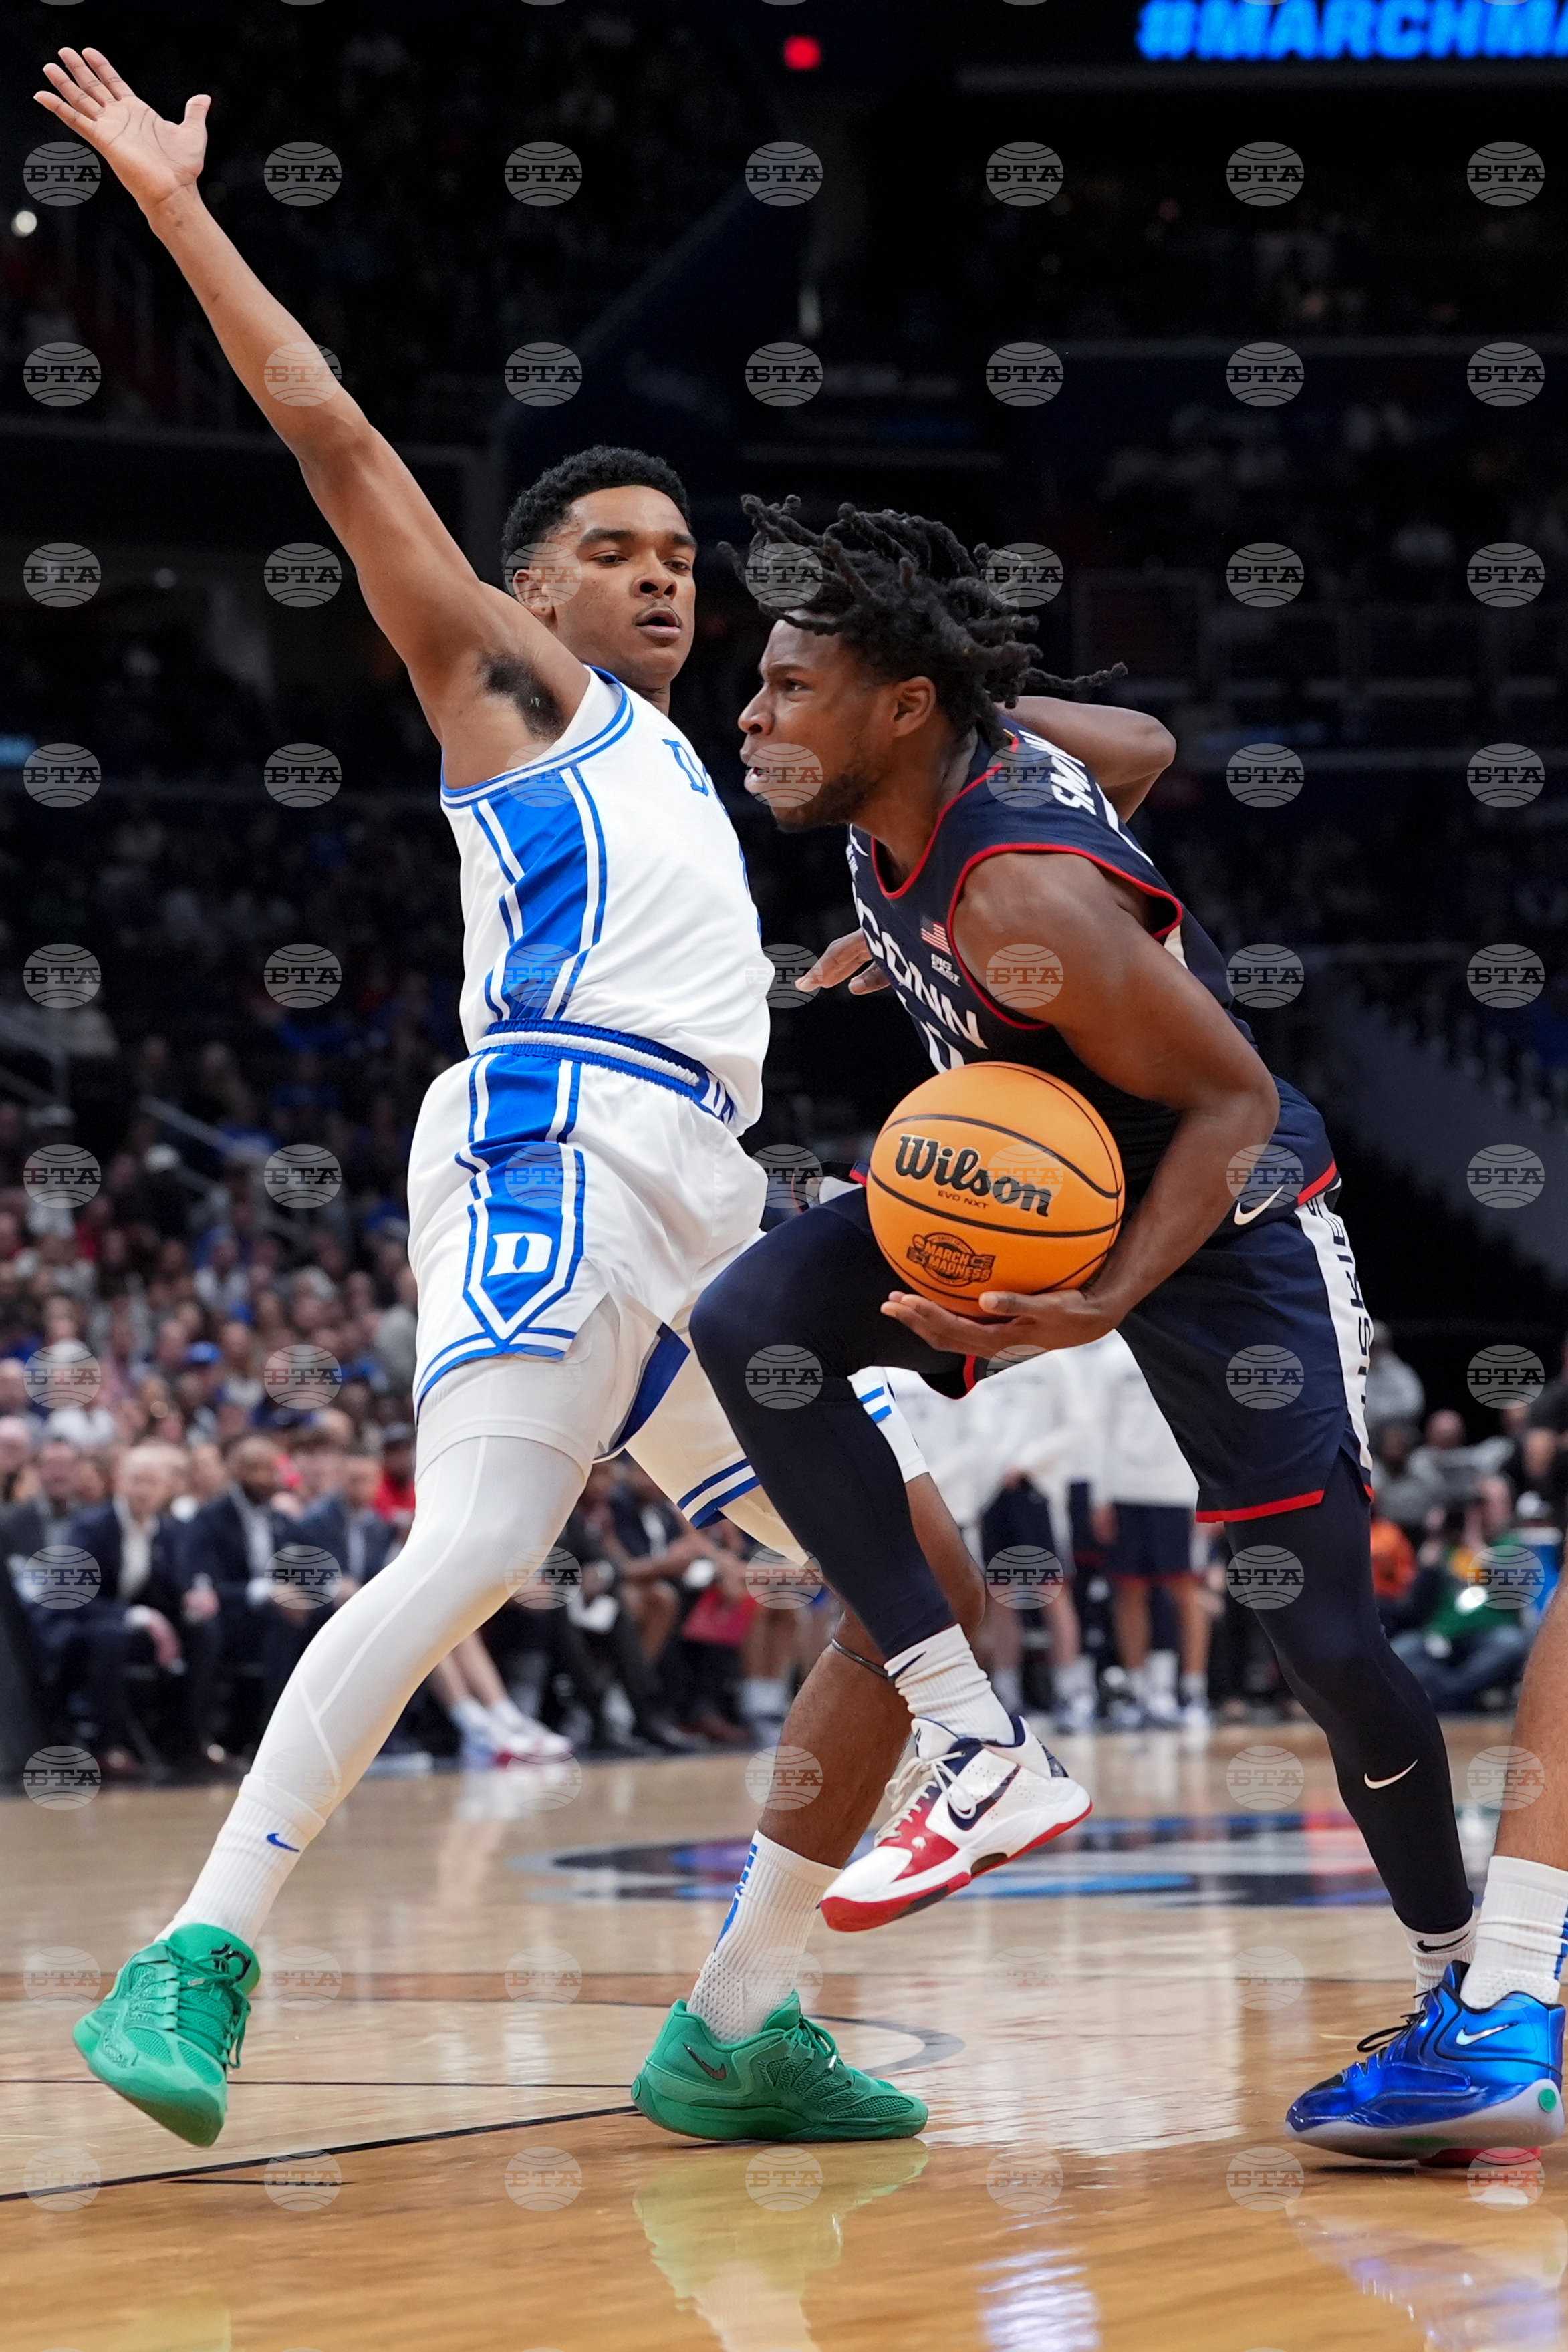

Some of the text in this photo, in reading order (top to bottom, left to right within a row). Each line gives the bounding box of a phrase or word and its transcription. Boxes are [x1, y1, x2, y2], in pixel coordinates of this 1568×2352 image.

[852, 881, 988, 1050] CONN
[895, 1134, 1051, 1218] Wilson
[938, 1189, 990, 1210] EVO NXT
[487, 1232, 553, 1277] D
[924, 1241, 972, 1266] MARCH
[928, 1255, 993, 1282] MADNESS
